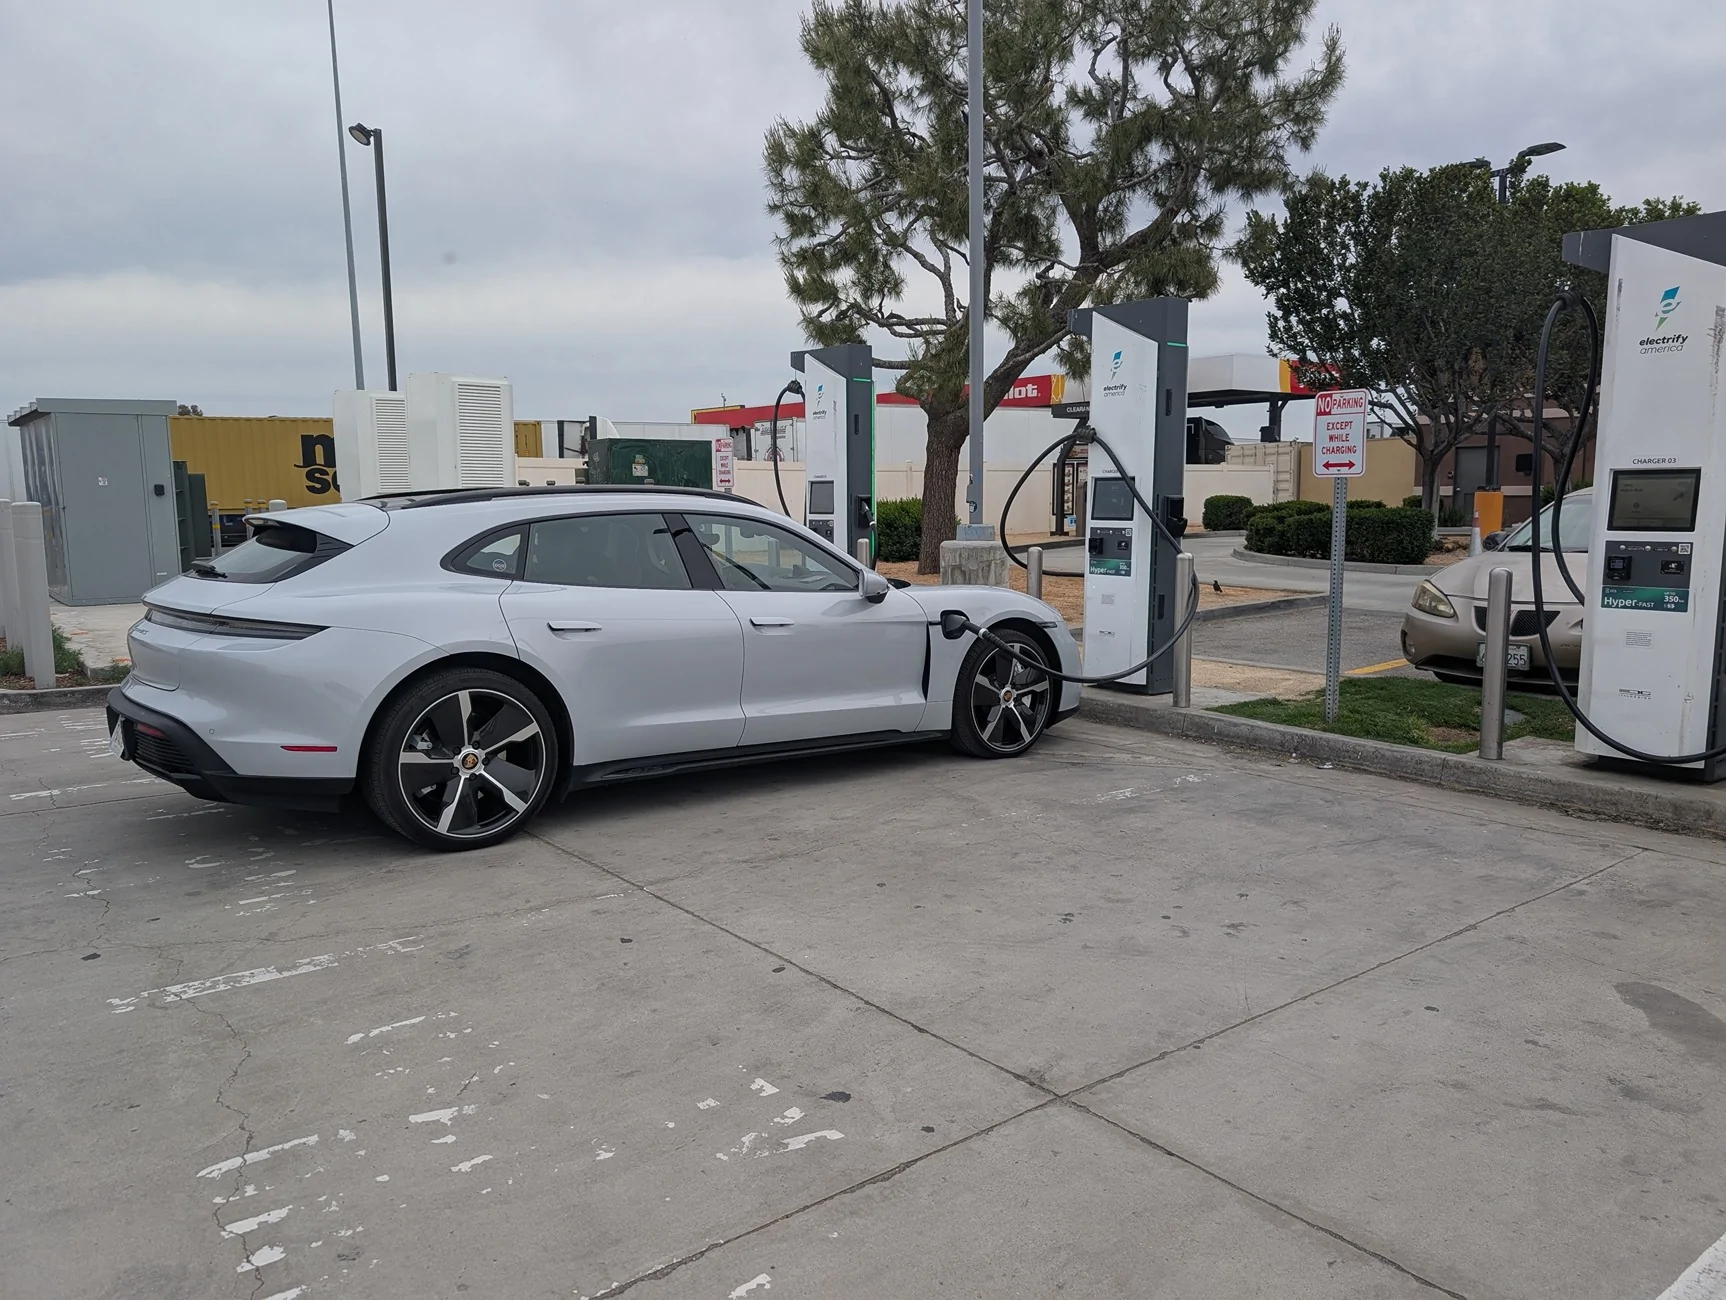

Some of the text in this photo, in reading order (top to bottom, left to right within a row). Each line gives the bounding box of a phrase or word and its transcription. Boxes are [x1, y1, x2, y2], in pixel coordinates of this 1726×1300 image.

[1639, 334, 1688, 346] electrify
[1640, 345, 1684, 355] america
[1004, 384, 1038, 399] lot
[1103, 384, 1127, 392] electrify
[1317, 397, 1363, 412] NO PARKING
[1326, 421, 1353, 430] EXCEPT
[1328, 433, 1349, 442] WHILE
[1321, 446, 1357, 455] CHARGING
[1632, 457, 1666, 465] CHARGER
[1663, 595, 1679, 603] 350
